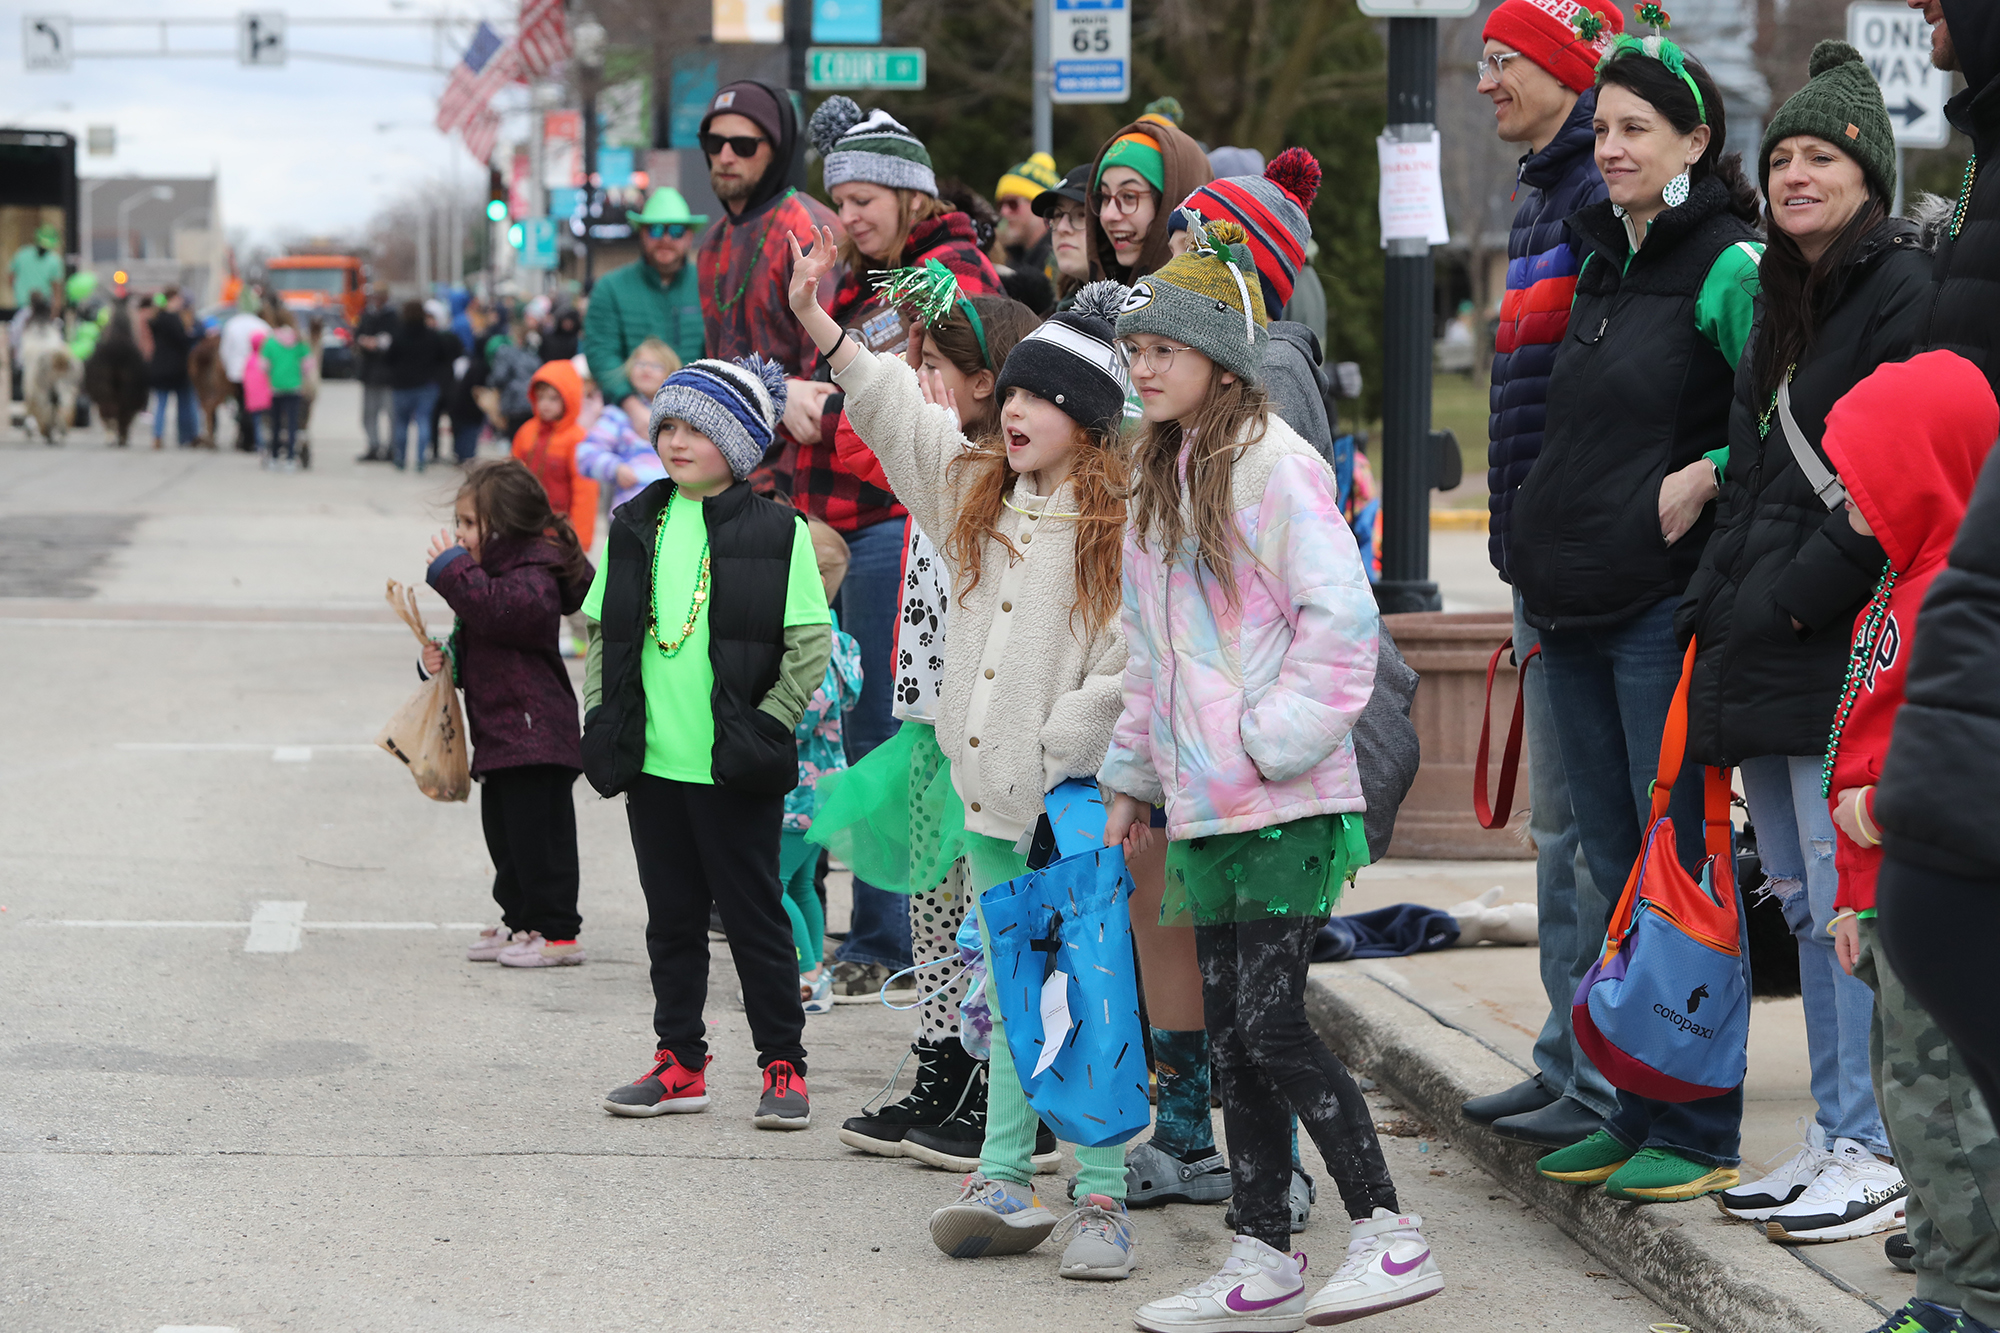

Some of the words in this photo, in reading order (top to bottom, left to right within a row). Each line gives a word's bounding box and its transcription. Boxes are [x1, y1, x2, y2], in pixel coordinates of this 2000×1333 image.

[1073, 29, 1109, 53] 65
[1865, 18, 1932, 49] ONE
[820, 53, 888, 83] COURT
[864, 313, 900, 338] FUN
[1653, 1003, 1715, 1040] cotopaxi
[1398, 1217, 1410, 1226] NIKE
